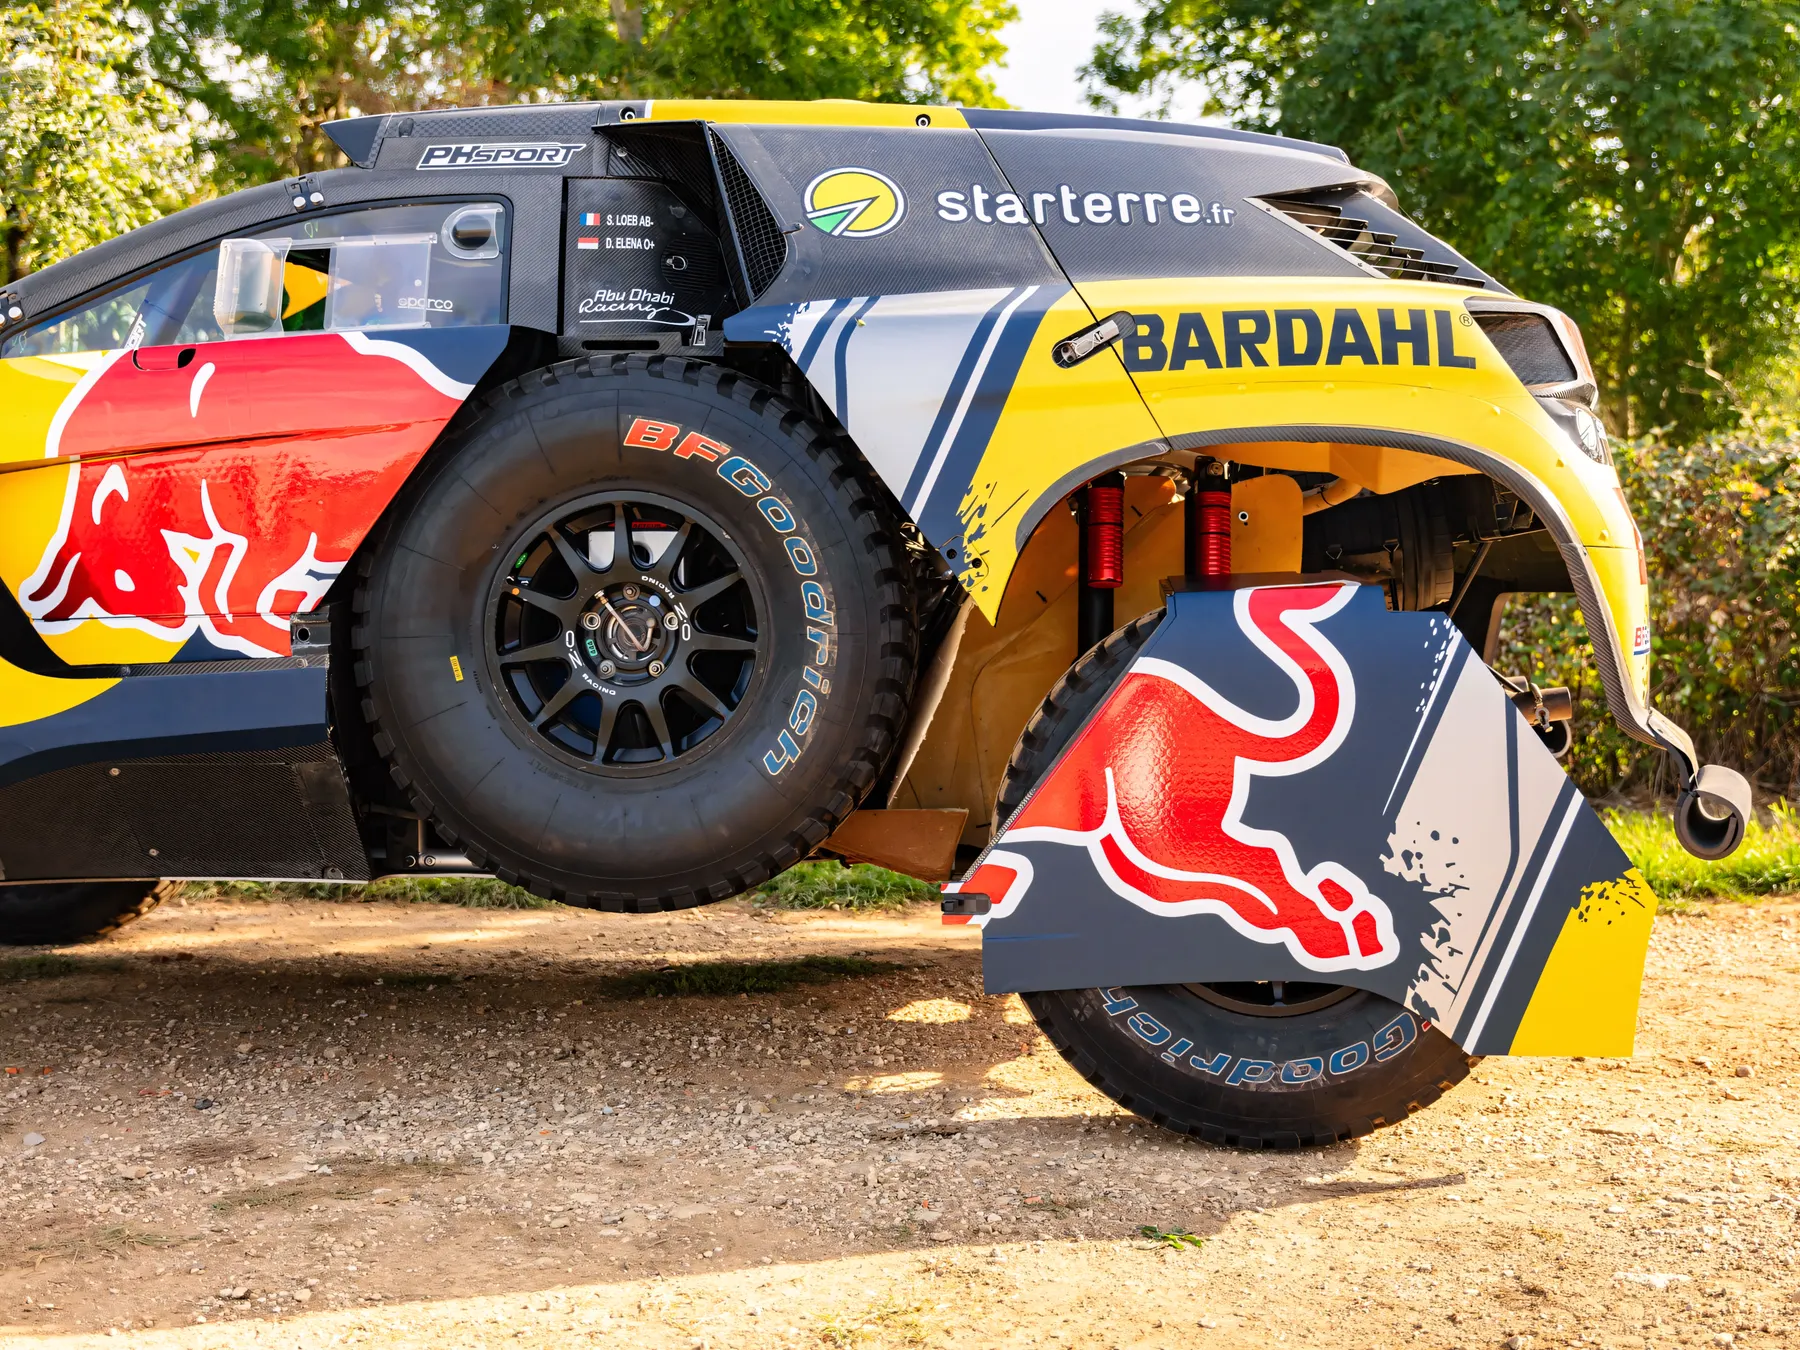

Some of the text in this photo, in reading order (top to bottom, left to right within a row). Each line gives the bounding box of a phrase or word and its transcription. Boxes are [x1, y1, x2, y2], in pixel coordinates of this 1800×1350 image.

[936, 184, 1235, 226] starterre.fr
[606, 214, 614, 226] S.
[616, 214, 638, 226] LOEB
[605, 237, 613, 249] D.
[615, 238, 643, 250] ELENA
[398, 297, 454, 311] sparco
[594, 288, 676, 305] Abu Dhabi
[578, 298, 671, 320] Racing
[623, 417, 836, 776] BFGoodrich
[641, 574, 676, 599] RACING
[581, 672, 617, 696] RACING
[1097, 986, 1432, 1085] Goodrich
